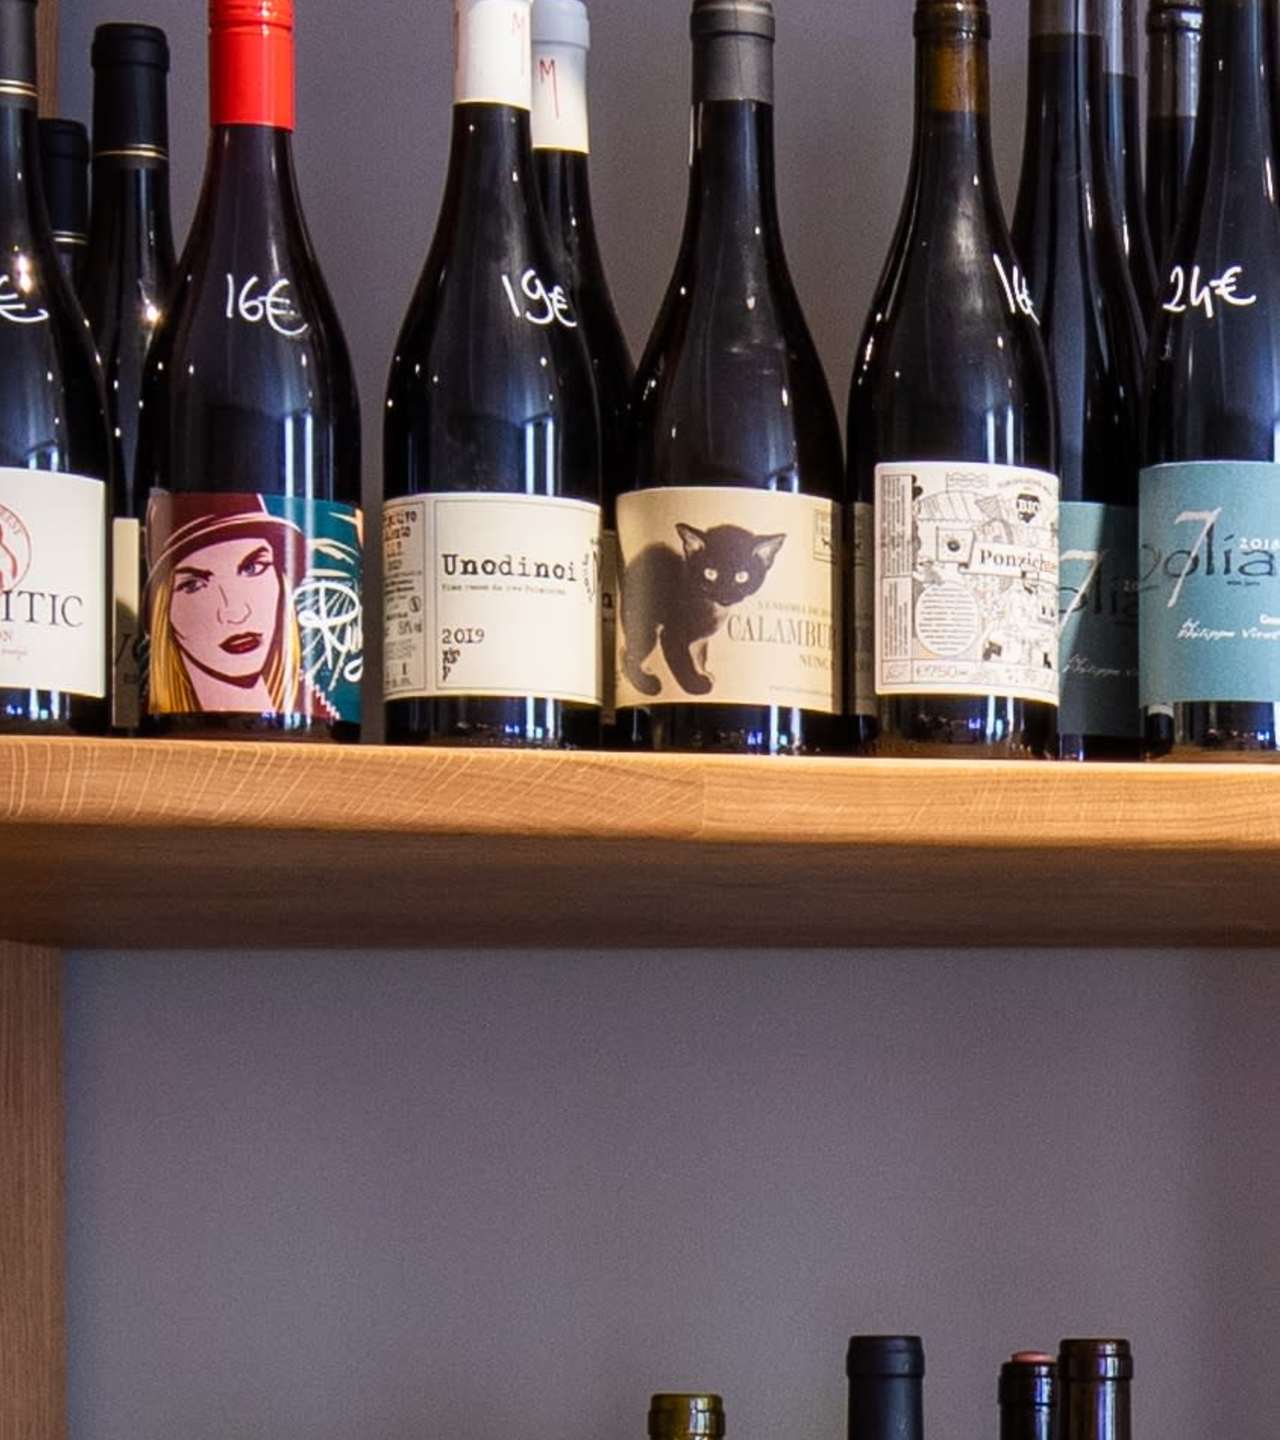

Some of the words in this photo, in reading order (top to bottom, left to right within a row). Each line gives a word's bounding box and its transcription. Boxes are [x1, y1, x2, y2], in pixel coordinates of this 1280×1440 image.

[225, 274, 309, 336] 16€
[509, 270, 579, 329] 19€
[1163, 265, 1257, 317] 24€
[442, 627, 486, 644] 2019
